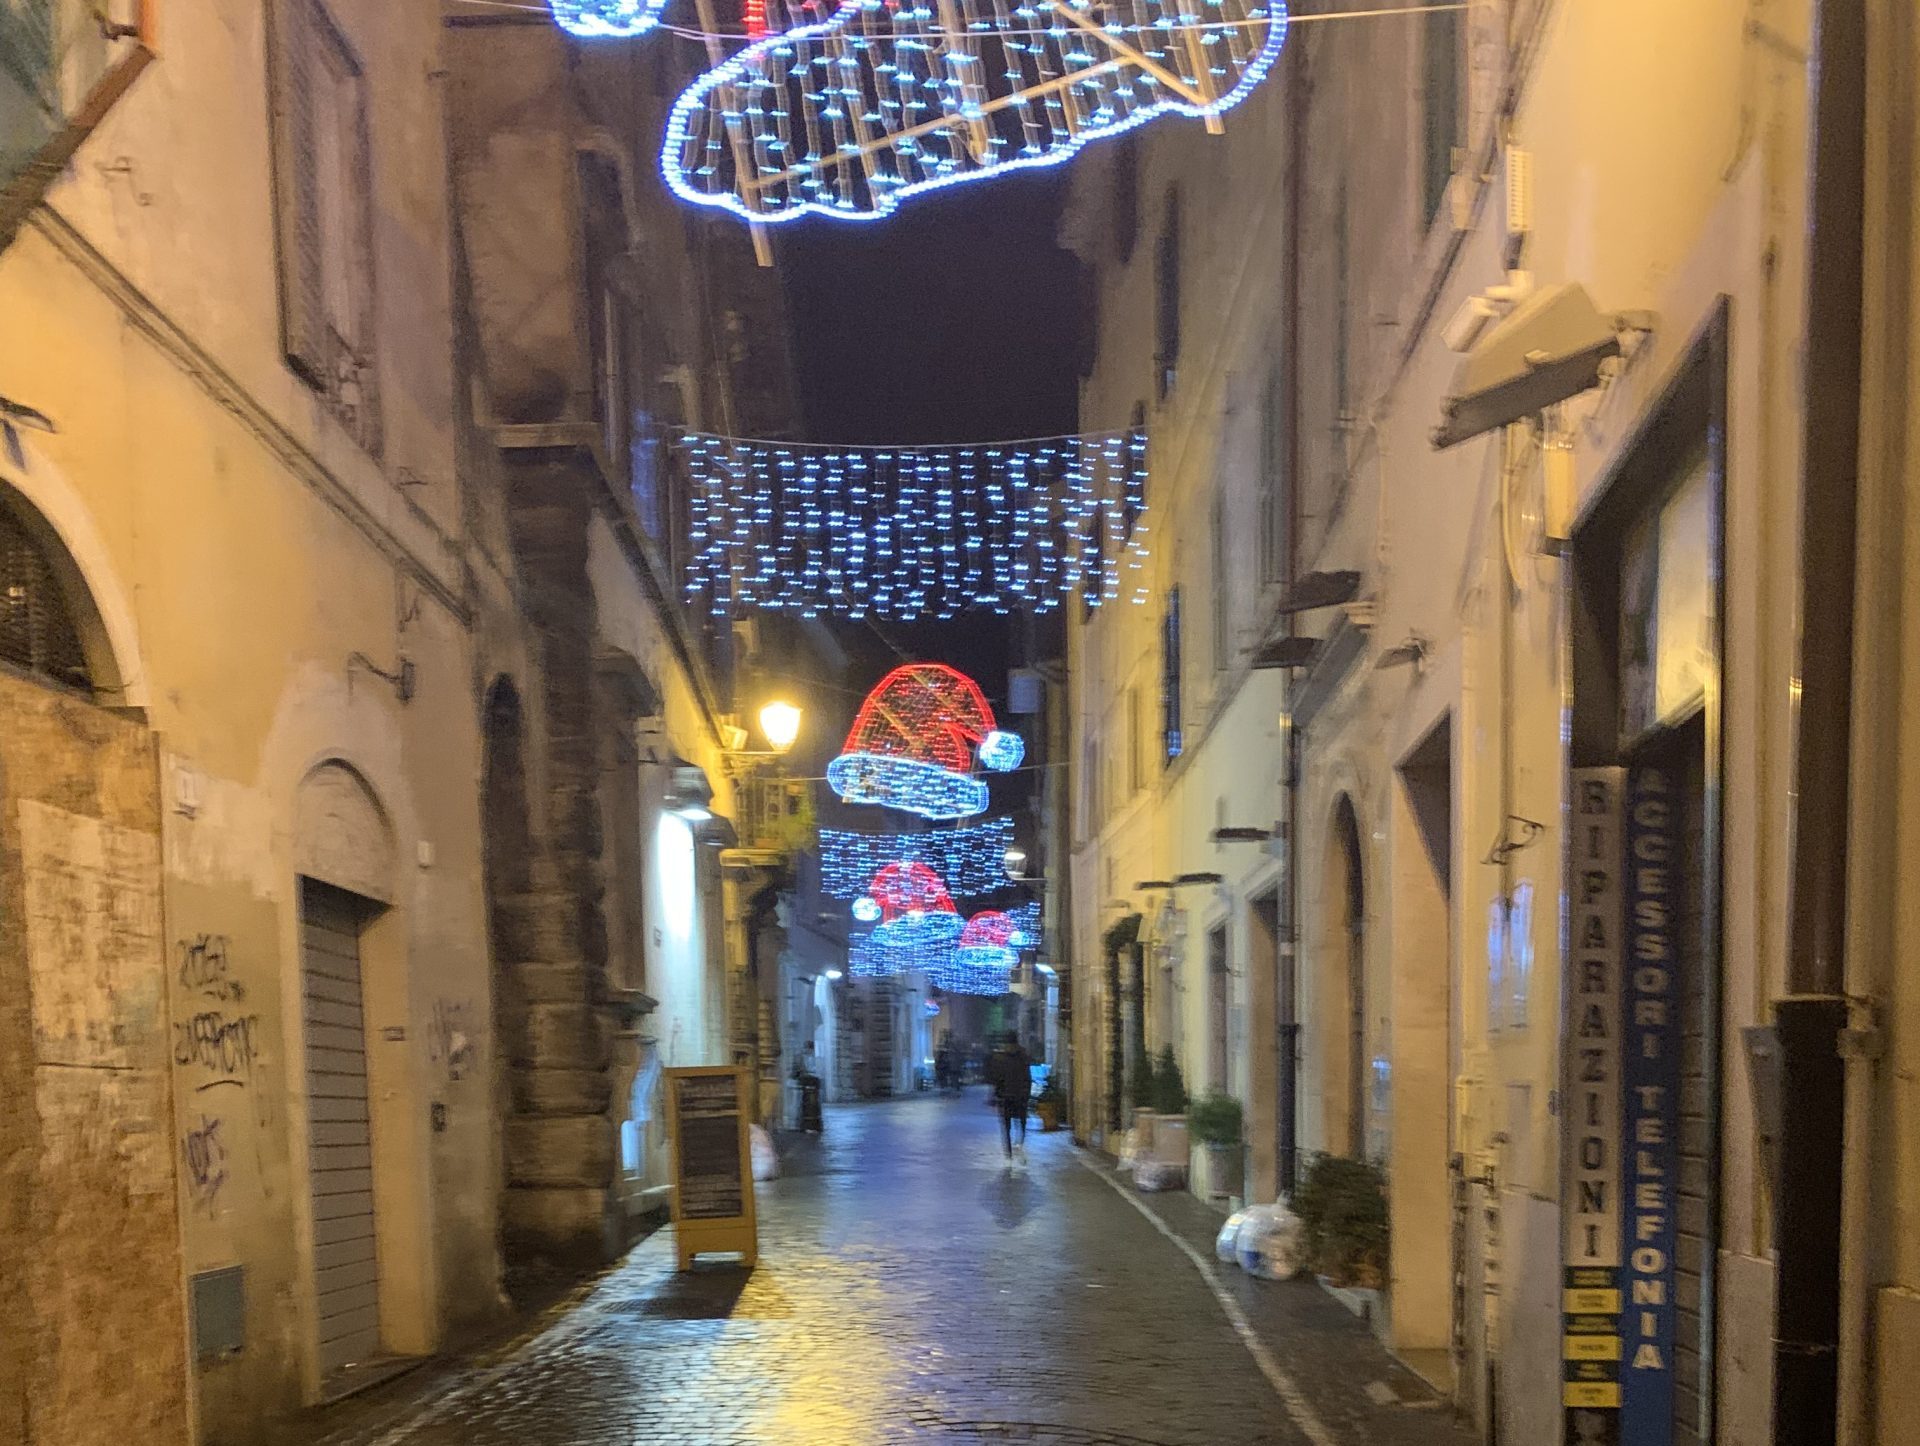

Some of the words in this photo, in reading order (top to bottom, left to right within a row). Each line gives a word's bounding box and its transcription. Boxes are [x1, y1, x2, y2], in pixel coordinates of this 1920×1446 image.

[1578, 779, 1609, 1258] RIPARAZIONI
[1632, 768, 1670, 1060] ACCESSORI
[1631, 1086, 1668, 1370] TELEFONIA
